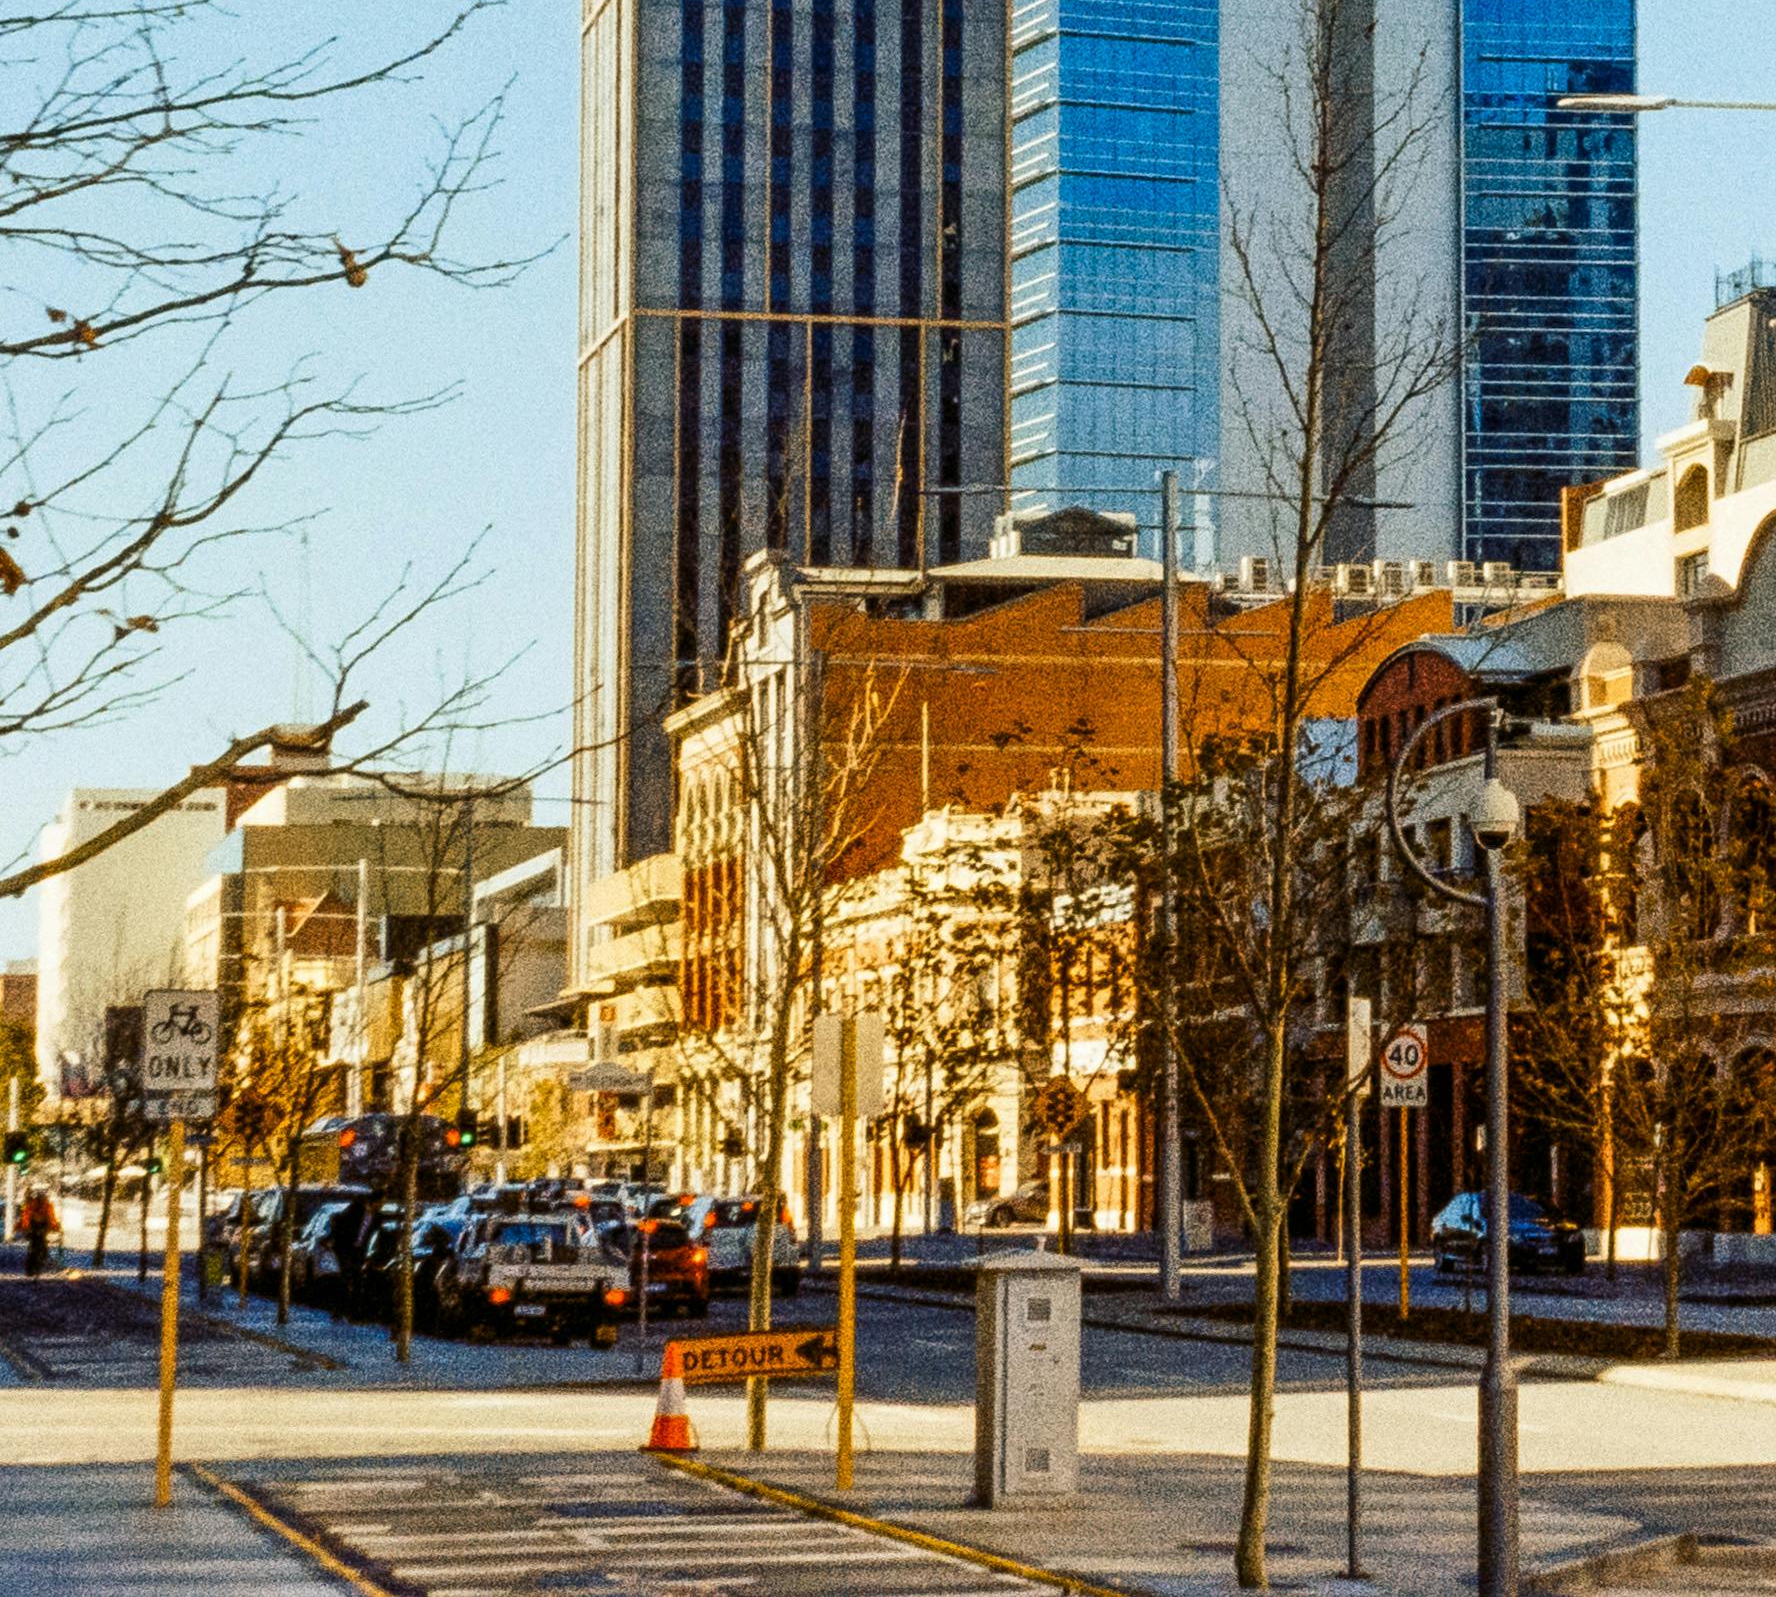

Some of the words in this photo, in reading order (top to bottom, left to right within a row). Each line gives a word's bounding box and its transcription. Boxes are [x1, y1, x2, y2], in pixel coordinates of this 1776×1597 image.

[1389, 1044, 1419, 1066] 40
[149, 1055, 211, 1078] ONLY
[1383, 1085, 1426, 1100] AREA
[683, 1345, 785, 1371] DETOUR
